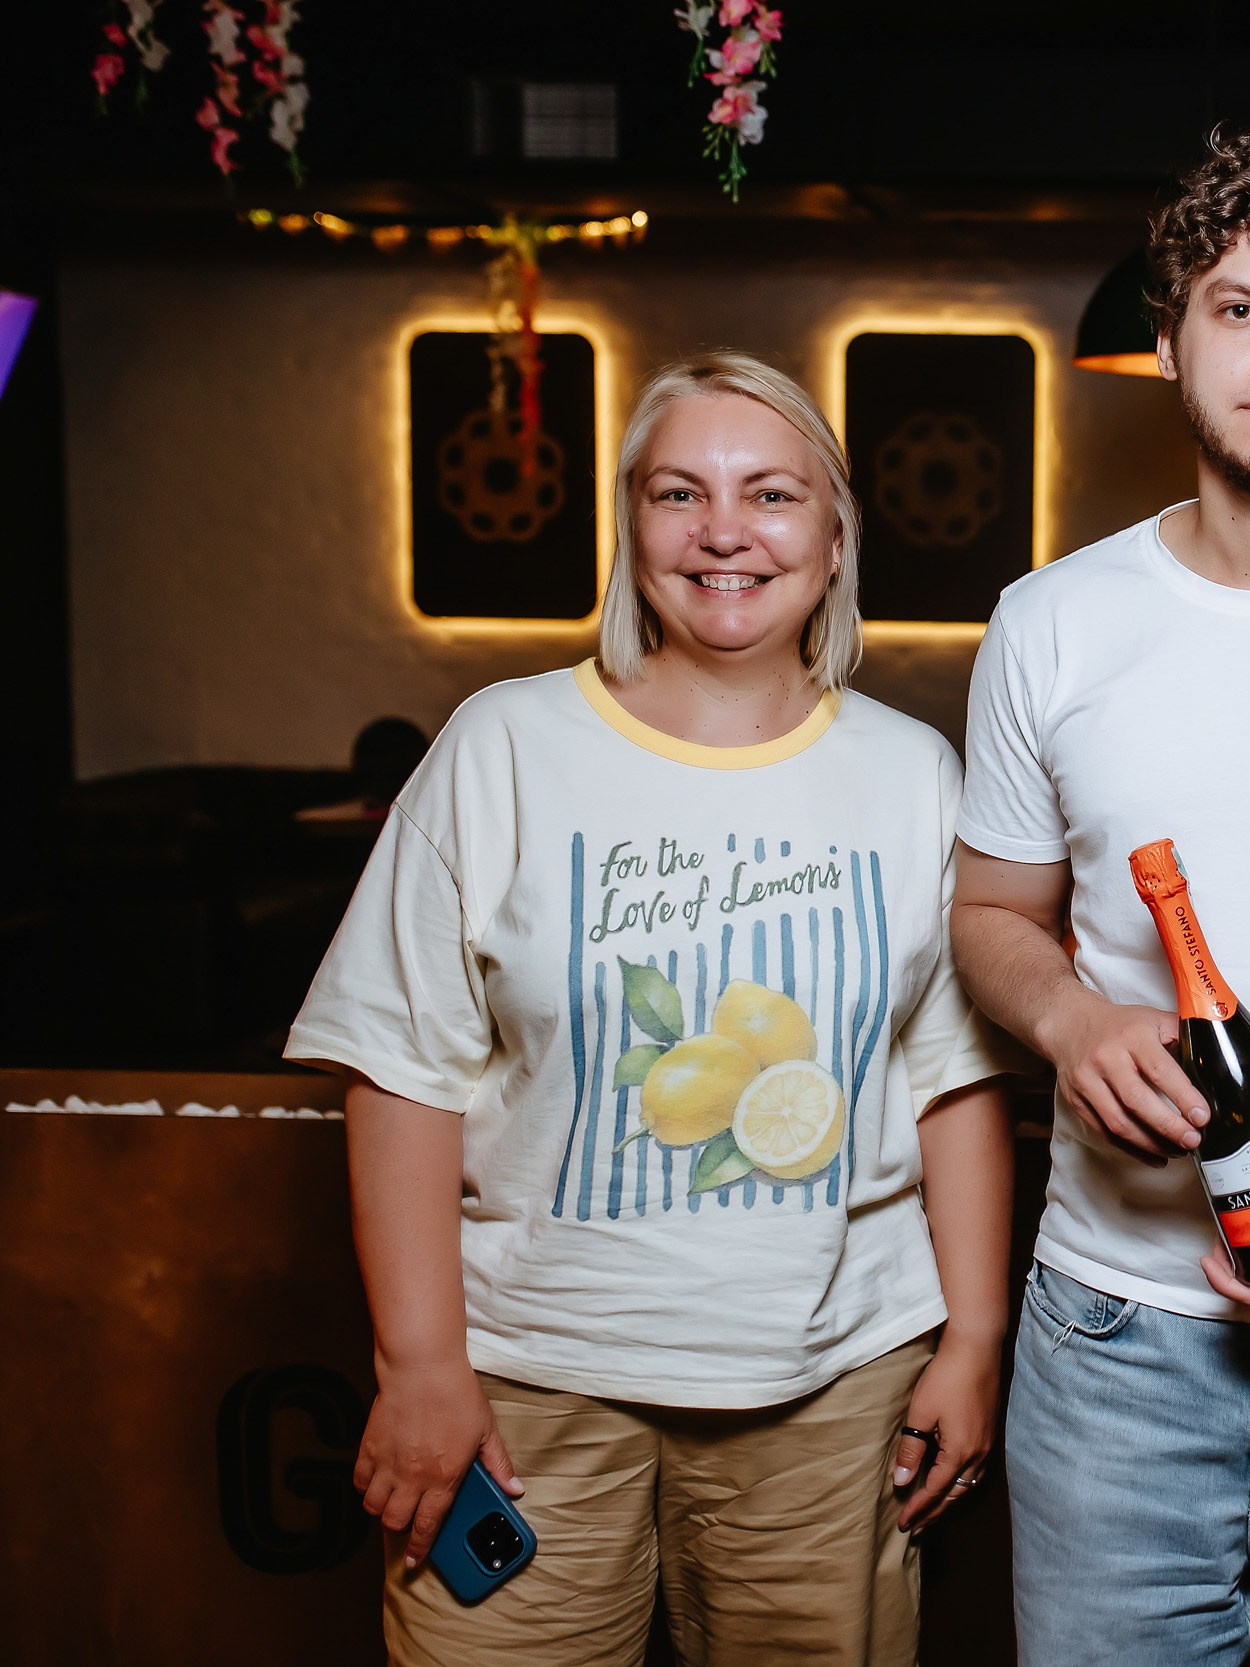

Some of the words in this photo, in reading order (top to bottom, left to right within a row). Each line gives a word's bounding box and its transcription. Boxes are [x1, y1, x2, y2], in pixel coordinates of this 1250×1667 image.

[600, 840, 648, 887] For
[657, 836, 705, 877] the
[588, 887, 677, 944] Love
[682, 875, 710, 932] of
[719, 861, 842, 914] Lemons
[1175, 906, 1201, 957] STEFANO
[1194, 959, 1218, 996] SANTO
